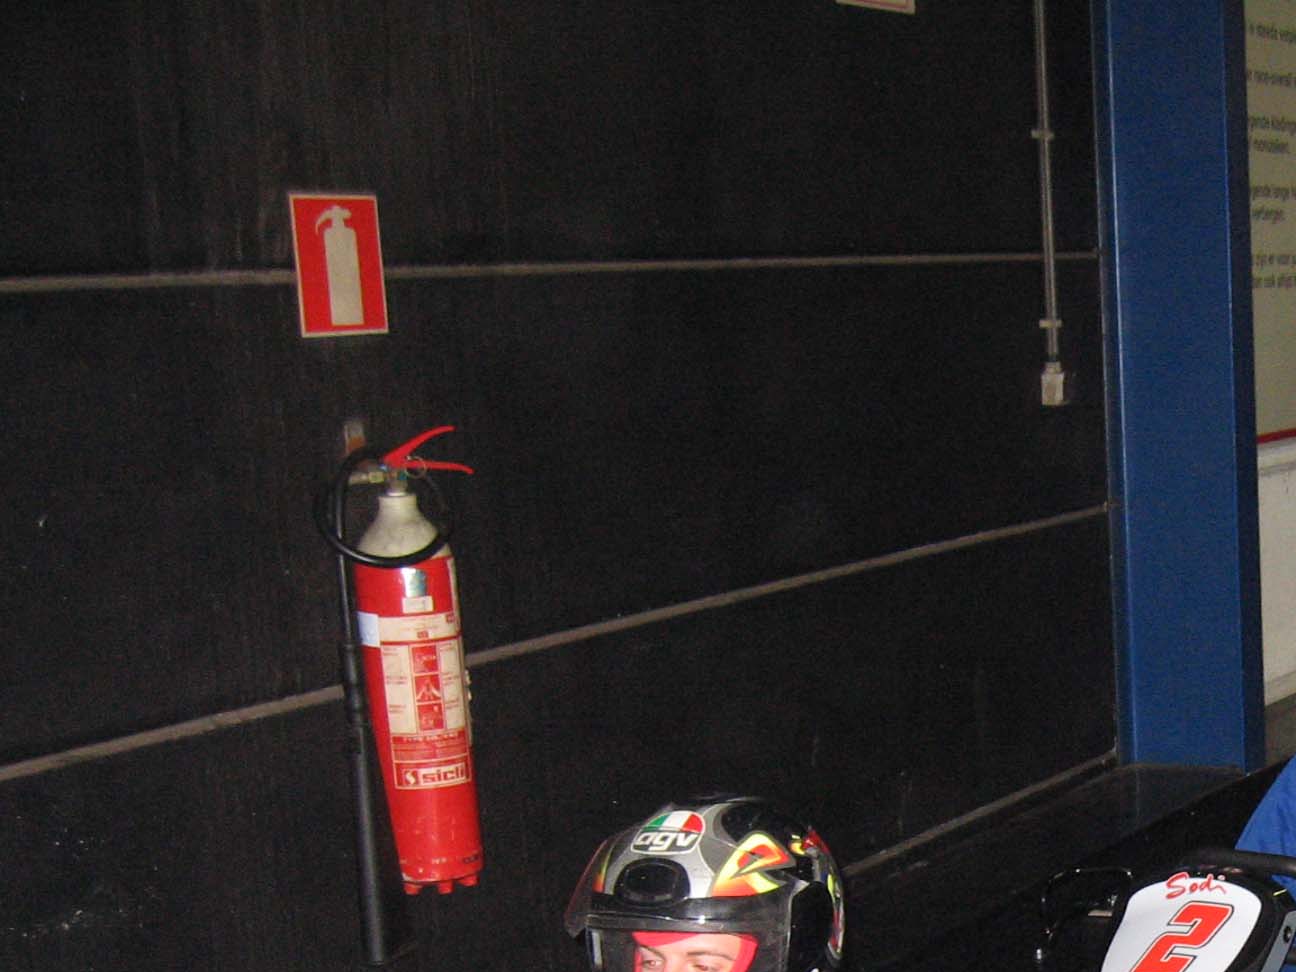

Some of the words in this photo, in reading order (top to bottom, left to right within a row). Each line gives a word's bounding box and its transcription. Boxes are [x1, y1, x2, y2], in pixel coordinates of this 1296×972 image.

[421, 766, 465, 784] sicli
[633, 831, 699, 851] agv
[1165, 871, 1227, 899] Sodi
